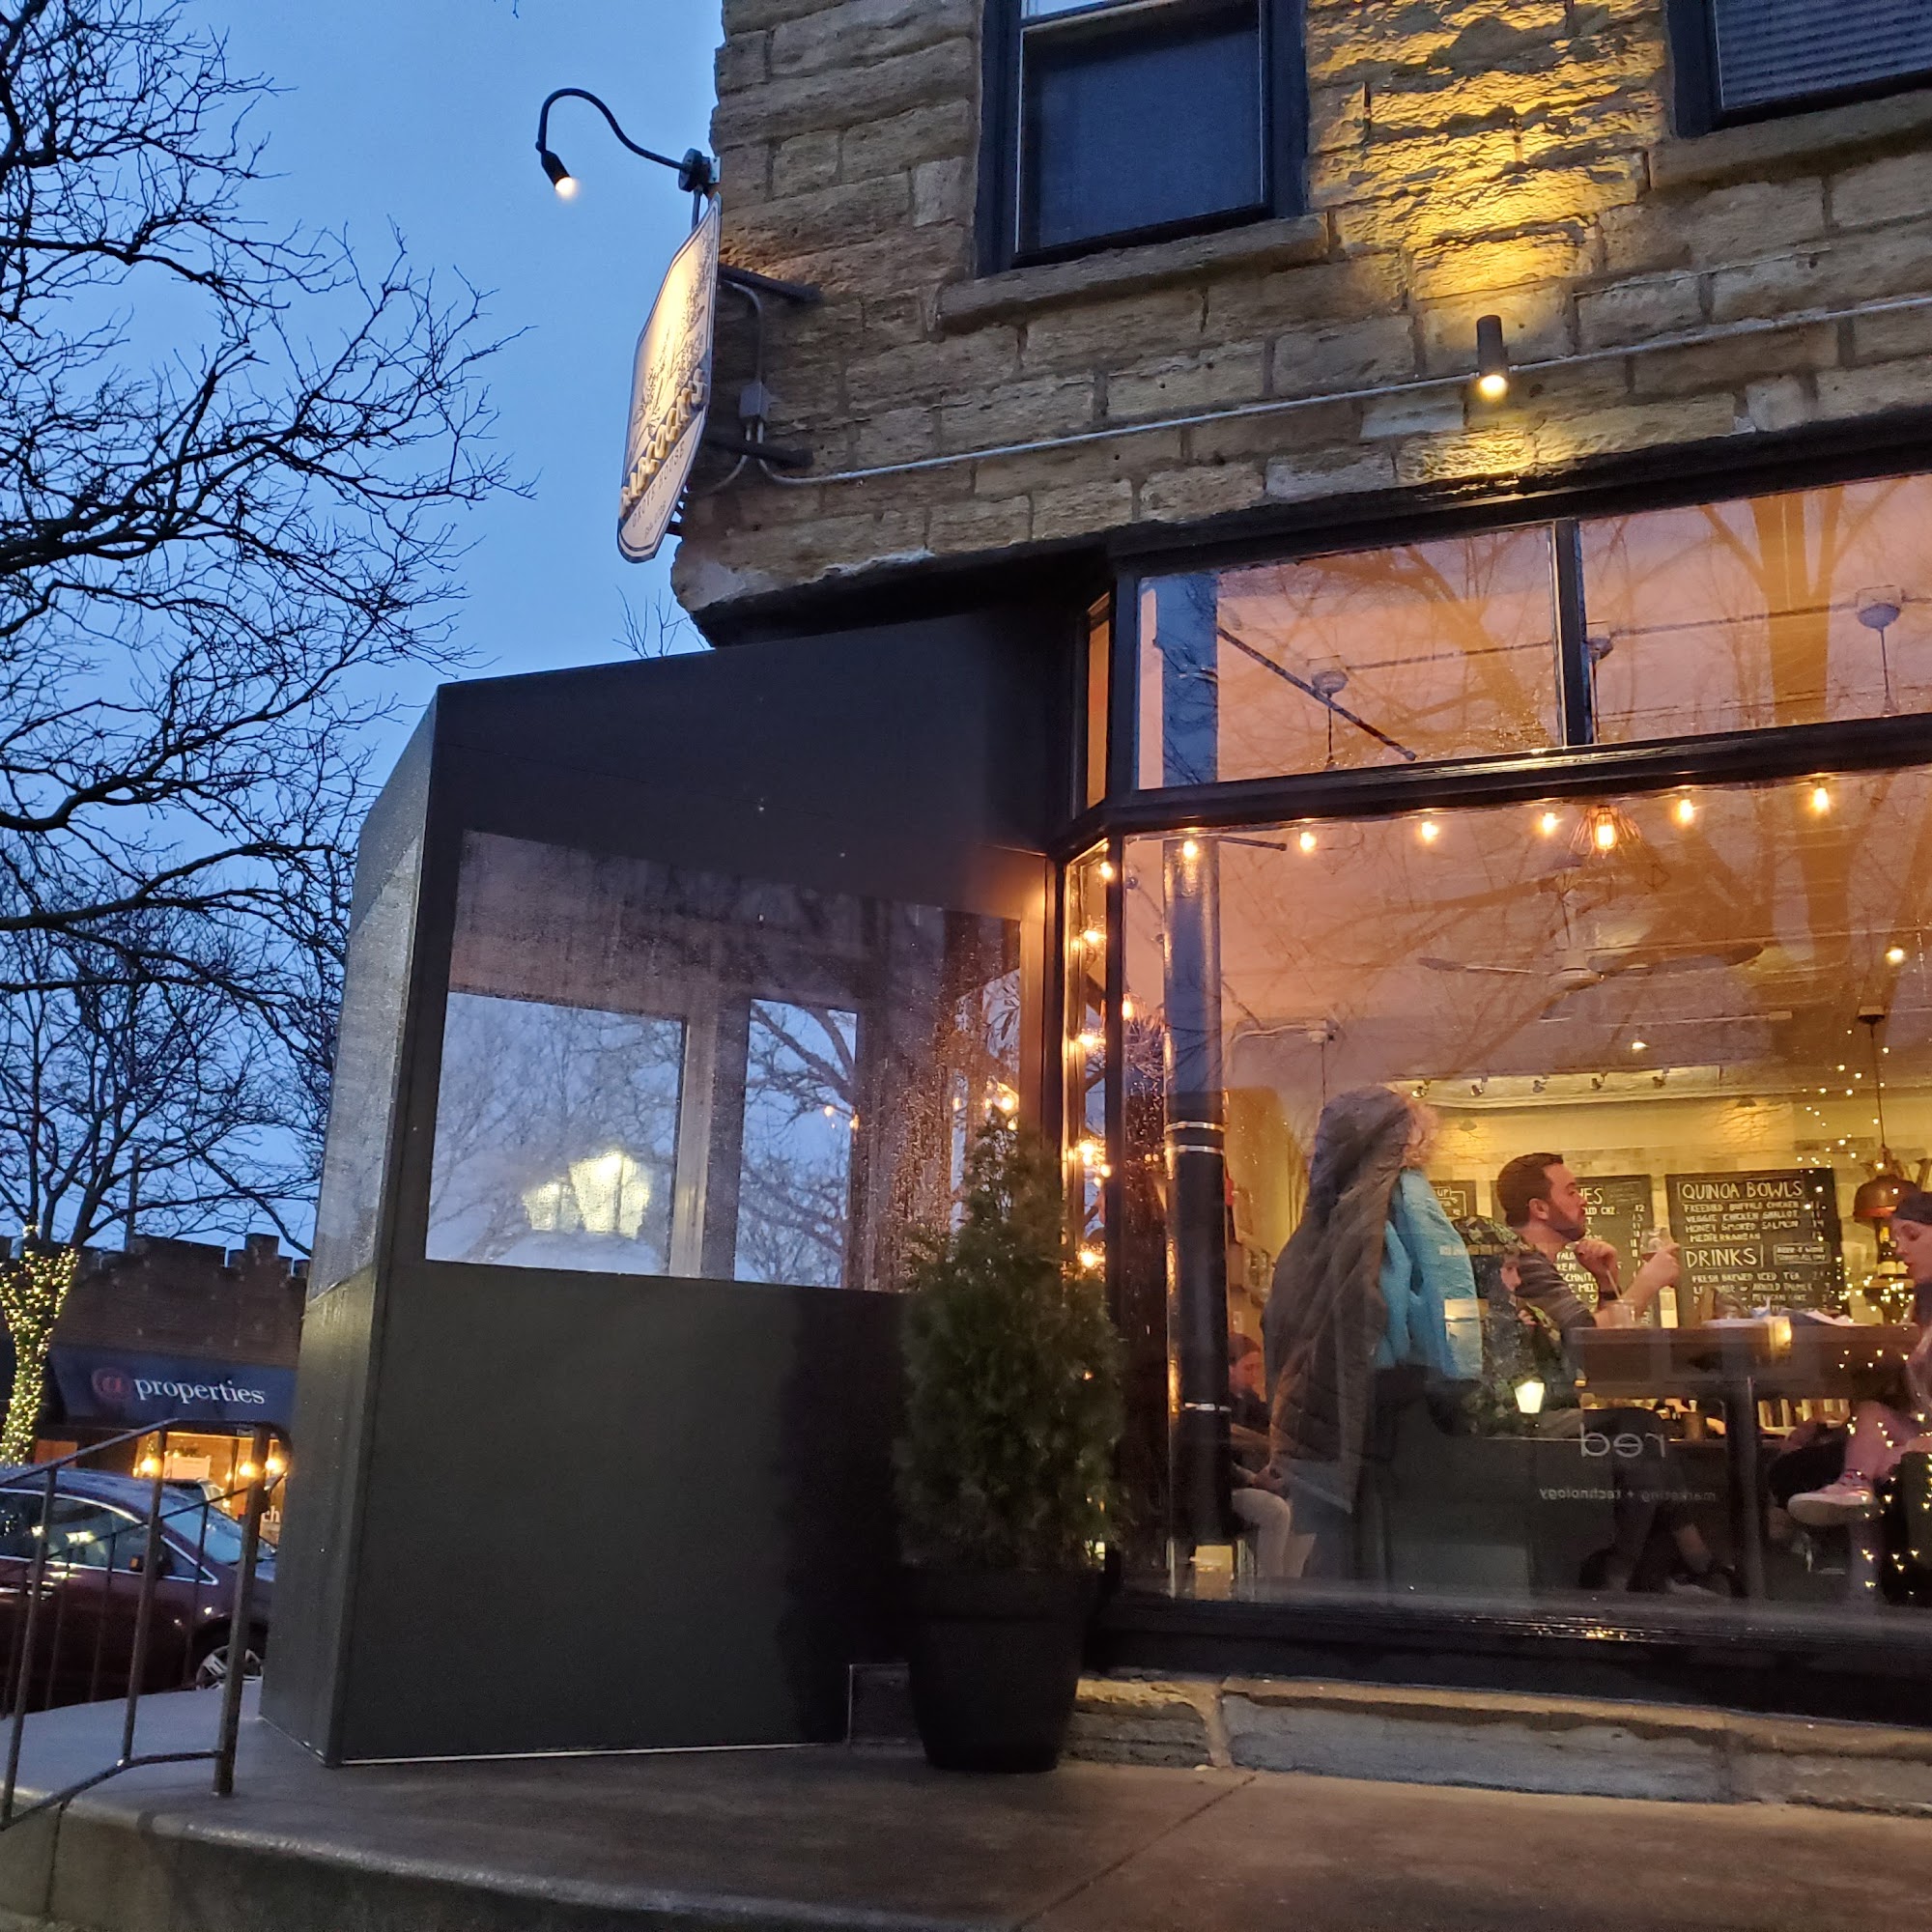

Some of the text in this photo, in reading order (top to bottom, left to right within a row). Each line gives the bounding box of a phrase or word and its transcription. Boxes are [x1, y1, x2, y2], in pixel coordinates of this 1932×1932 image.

[659, 440, 685, 490] HOUSE
[1682, 1180, 1804, 1200] QUINOA BOWLS
[1766, 1200, 1799, 1208] CHICKEN
[1685, 1214, 1718, 1223] VEGGIE
[1722, 1212, 1759, 1222] CHICKEN
[1685, 1224, 1717, 1234] HONEY
[1721, 1222, 1756, 1232] SMOKED
[1762, 1220, 1799, 1230] SALMON
[1686, 1247, 1757, 1268] DRINKS
[1692, 1273, 1719, 1283] FRESH
[1782, 1271, 1800, 1281] TEA
[133, 1375, 266, 1405] properties
